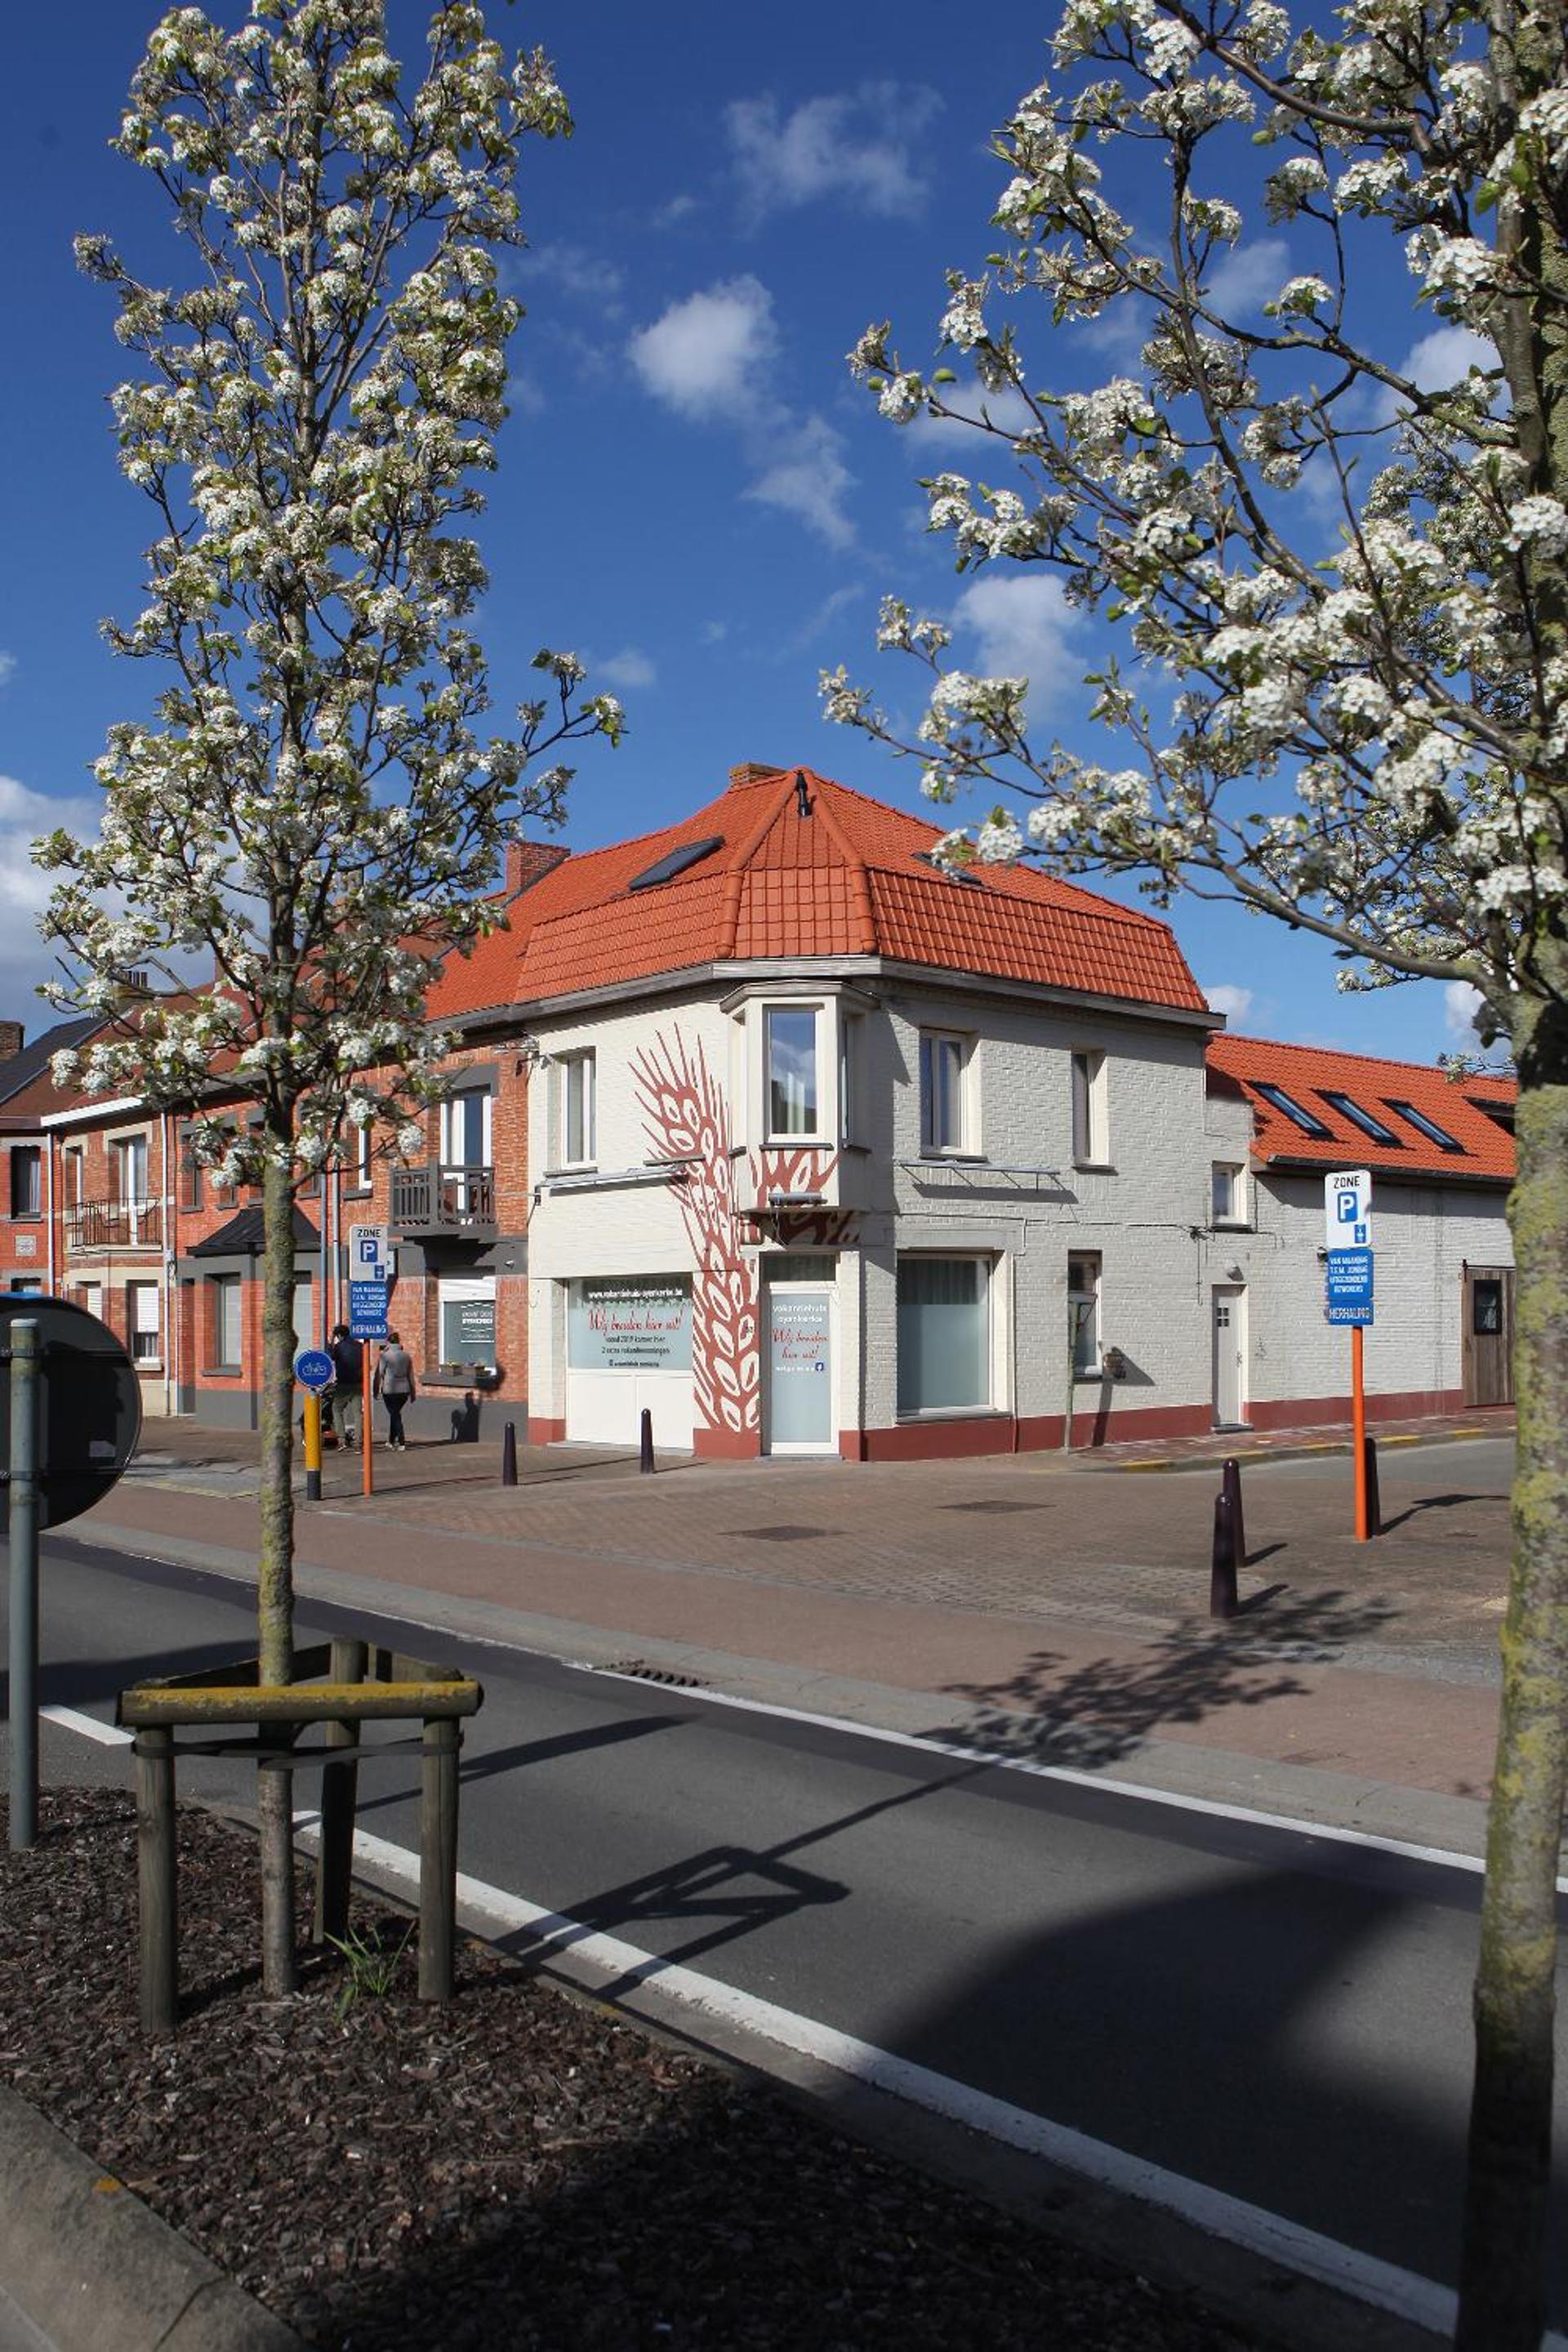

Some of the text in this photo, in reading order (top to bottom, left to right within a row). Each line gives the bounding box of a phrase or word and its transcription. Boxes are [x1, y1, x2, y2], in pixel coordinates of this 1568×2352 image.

[1334, 1175, 1360, 1189] ZONE
[1340, 1196, 1355, 1220] P
[357, 1228, 381, 1238] ZONE
[363, 1243, 376, 1261] P
